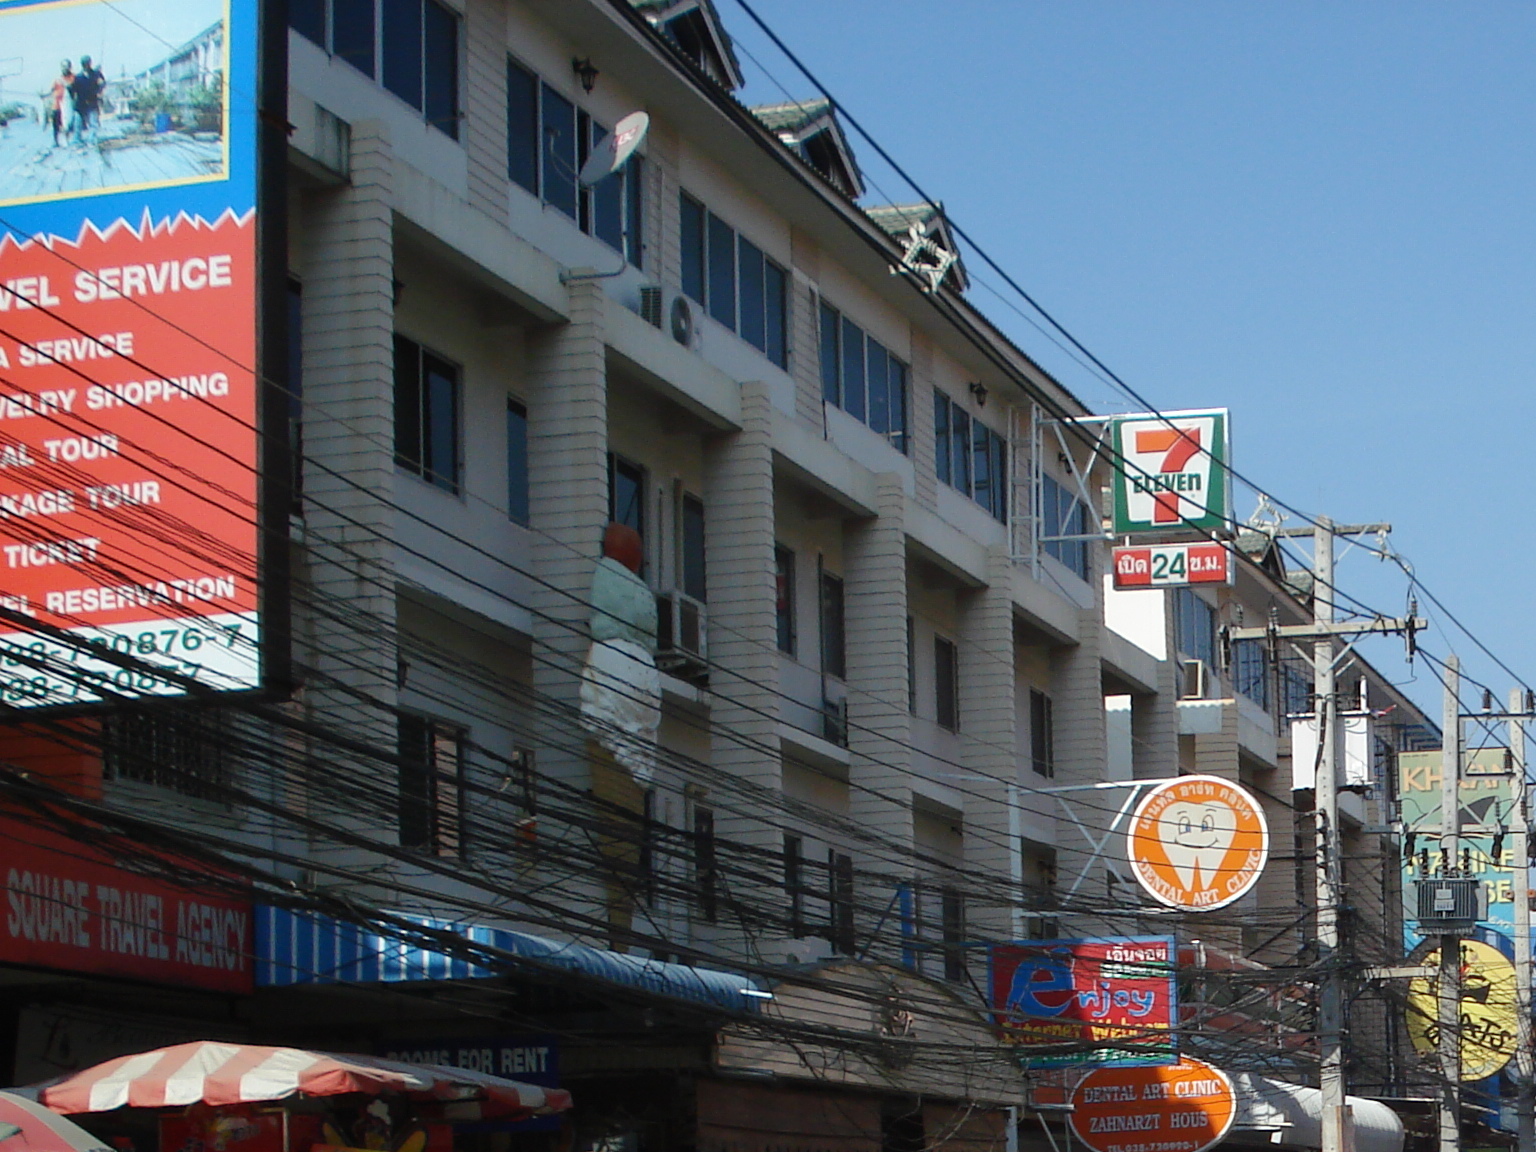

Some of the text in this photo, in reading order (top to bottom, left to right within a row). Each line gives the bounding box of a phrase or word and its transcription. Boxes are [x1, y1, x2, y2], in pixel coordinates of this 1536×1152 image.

[74, 254, 232, 303] SERVICE
[18, 332, 134, 368] SERVICE
[86, 372, 229, 411] SHOPPING
[44, 433, 119, 463] TOUR
[85, 480, 161, 511] TOUR
[4, 537, 101, 568] TICKET
[1117, 551, 1187, 580] เปิด 24
[46, 575, 236, 615] RESERVATION
[1138, 847, 1261, 906] DENTAL ART CLINIC
[7, 867, 247, 972] SQUARE TRAVEL AGENCY
[457, 1048, 493, 1075] FOR
[501, 1046, 548, 1073] RENT
[1084, 1079, 1222, 1103] DENTAL ART CLINIC
[1089, 1112, 1208, 1133] ZAHNARZT HOUS
